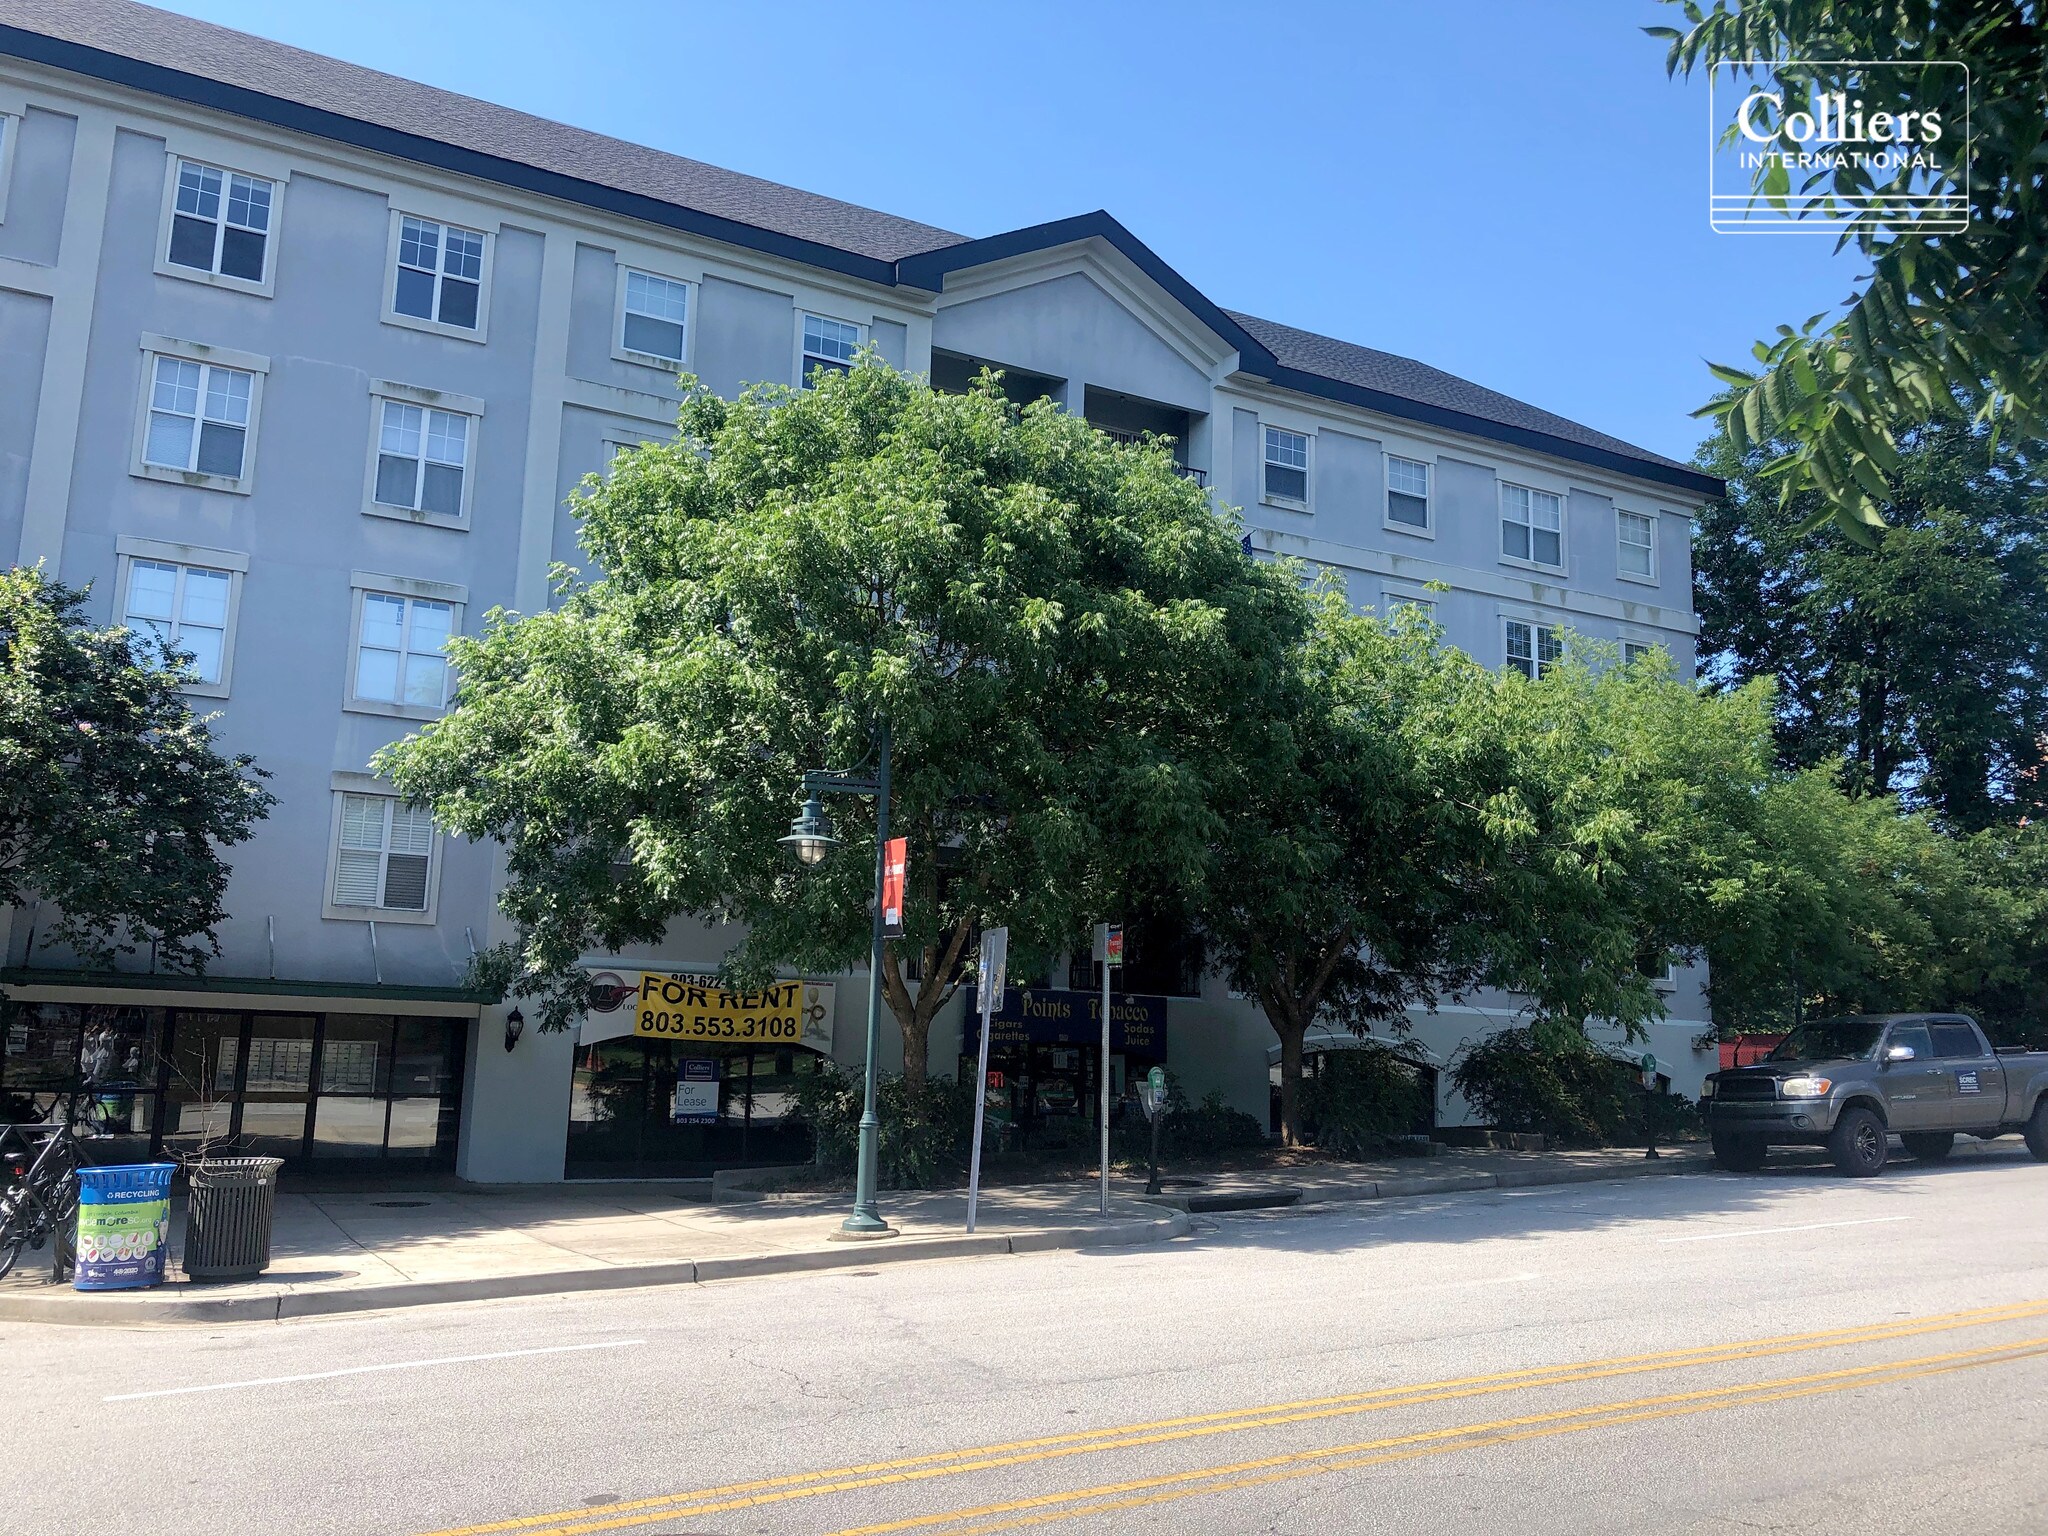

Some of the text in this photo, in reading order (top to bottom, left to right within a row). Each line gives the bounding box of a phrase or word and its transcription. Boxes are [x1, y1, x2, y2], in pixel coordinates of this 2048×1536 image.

[642, 975, 800, 1010] FOR RENT
[1022, 997, 1071, 1021] Points
[640, 1010, 797, 1038] 803.553.3108
[1124, 1022, 1155, 1034] Sodas
[976, 1030, 1030, 1042] Cgarettes
[1125, 1034, 1150, 1046] Juice
[678, 1084, 696, 1095] For
[677, 1096, 707, 1107] Lease
[114, 1189, 160, 1199] RECYCLING
